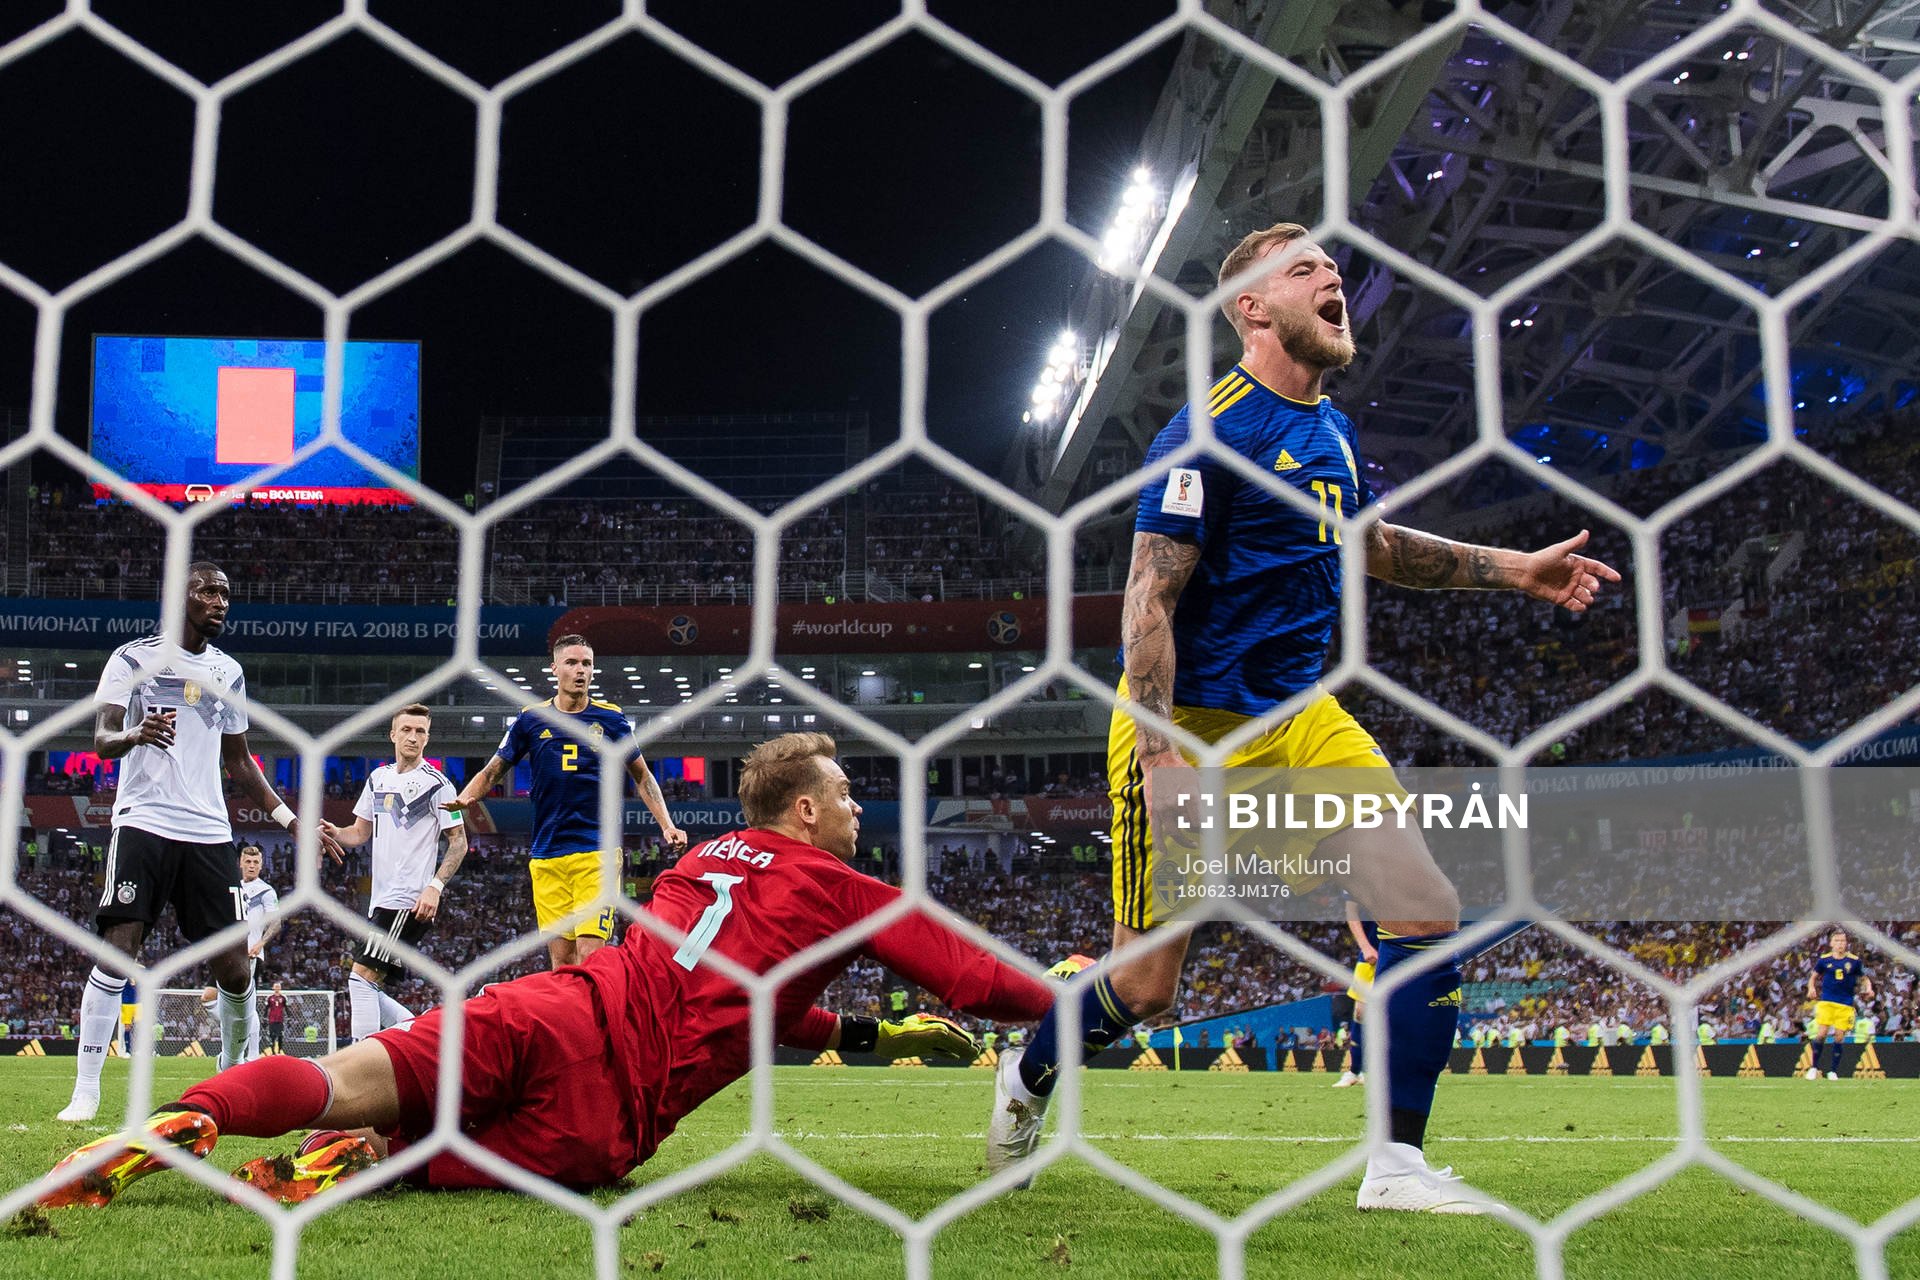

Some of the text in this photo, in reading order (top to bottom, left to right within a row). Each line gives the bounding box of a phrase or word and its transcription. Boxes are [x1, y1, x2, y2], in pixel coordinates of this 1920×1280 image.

[269, 490, 323, 500] BOATENG
[1311, 480, 1343, 545] 11
[221, 619, 308, 637] УТБОЛУ
[314, 621, 357, 638] FIFA
[363, 622, 409, 639] 2018
[434, 623, 519, 639] РОСИИ
[791, 619, 893, 638] #worldcup
[562, 744, 578, 771] 2
[236, 808, 278, 823] SOC
[671, 810, 731, 826] WORLD
[1049, 803, 1113, 821] #world
[672, 872, 745, 972] 1
[83, 1045, 102, 1054] DFB
